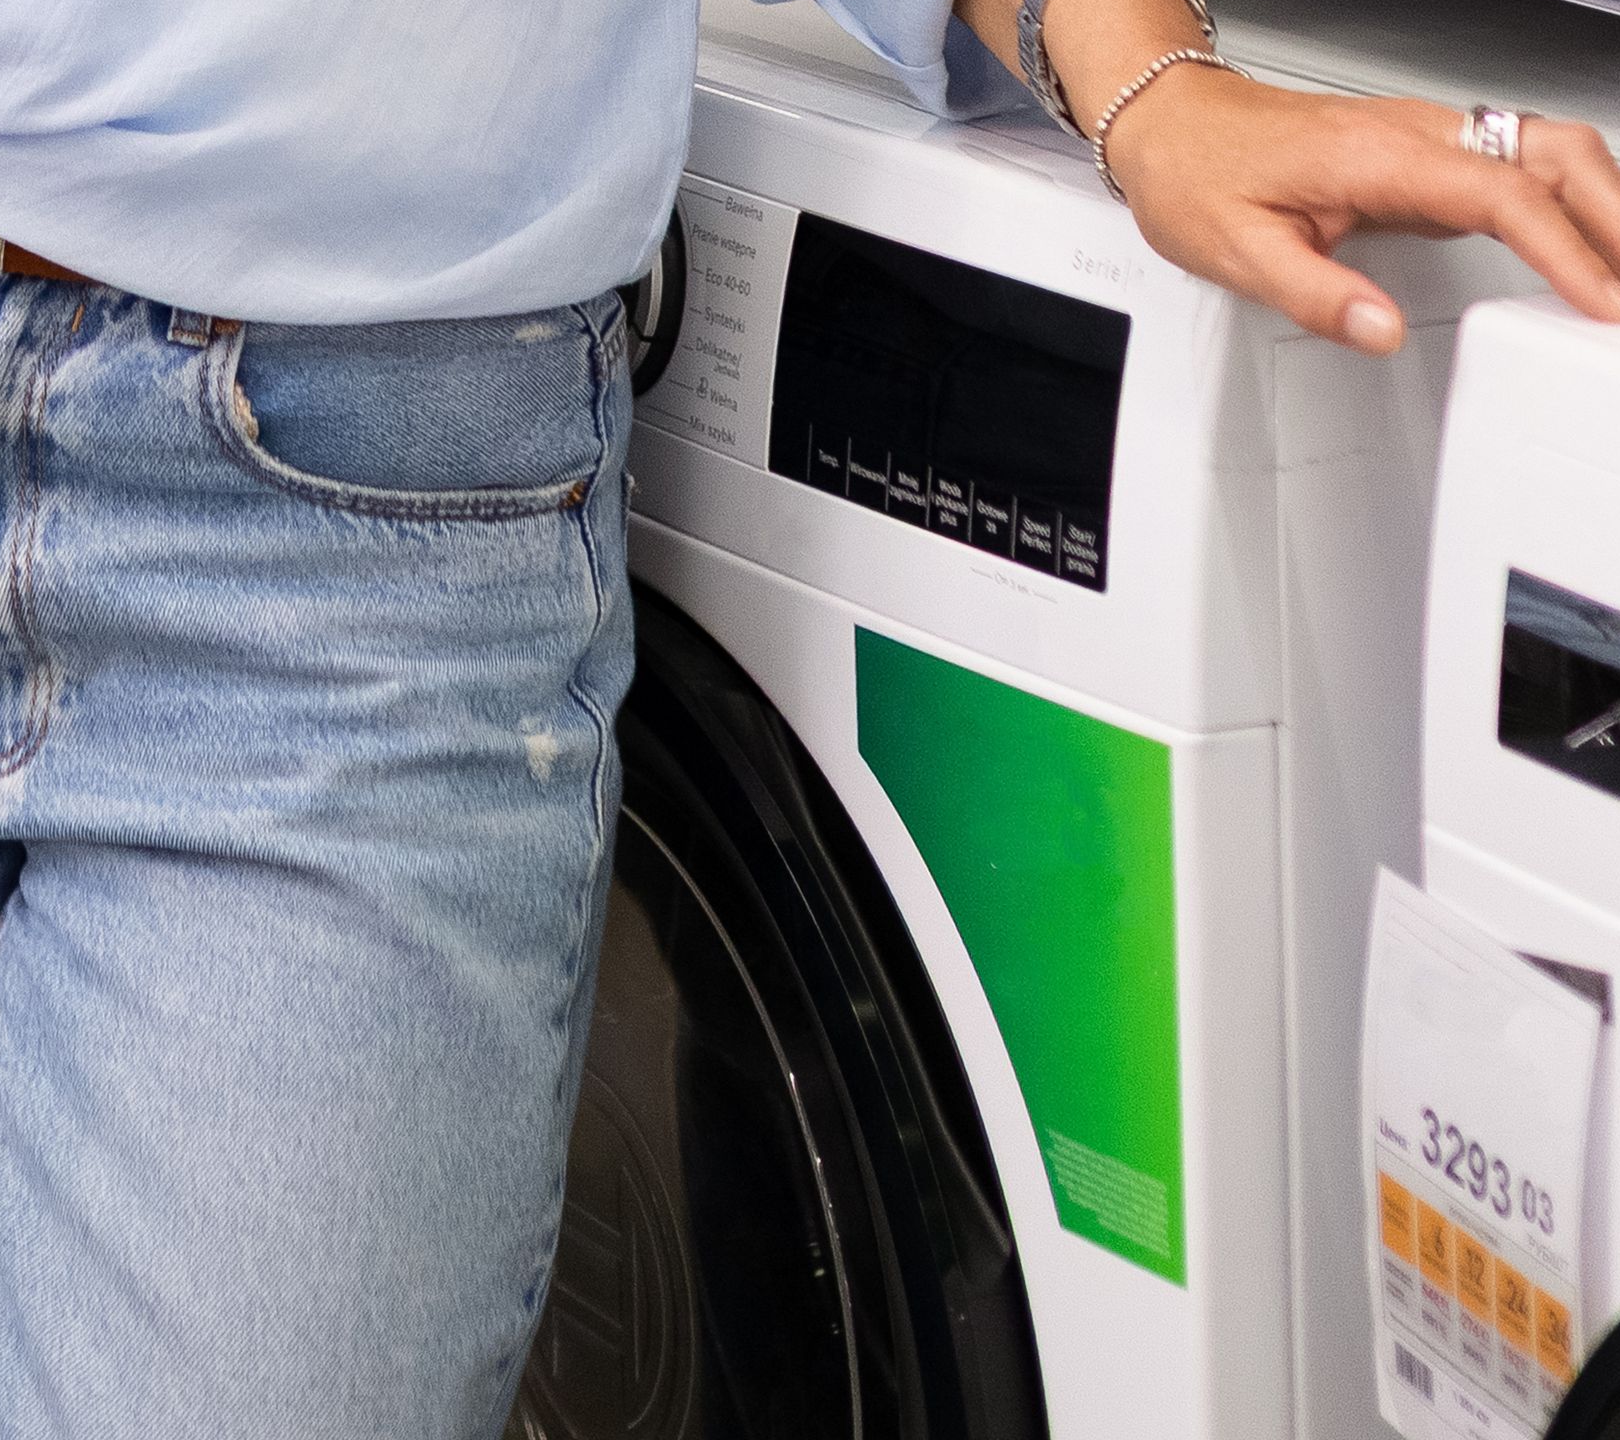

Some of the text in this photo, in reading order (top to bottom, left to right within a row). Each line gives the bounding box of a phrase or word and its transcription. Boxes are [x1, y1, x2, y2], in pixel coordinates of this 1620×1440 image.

[724, 195, 764, 222] Bawełna
[691, 222, 758, 260] Pranie wstępne
[1071, 247, 1121, 283] Serie
[705, 267, 752, 297] Eco 40-60
[704, 305, 746, 334] Syntetyki
[695, 336, 743, 368] Delikatne/
[710, 388, 739, 413] Wełna
[688, 414, 737, 447] Mix szybki
[1022, 514, 1052, 539] Speed
[1067, 522, 1097, 549] Start/
[1020, 529, 1053, 555] Perfect
[1422, 1106, 1512, 1220] 3293
[1522, 1178, 1555, 1236] 03
[1505, 1277, 1530, 1319] 24
